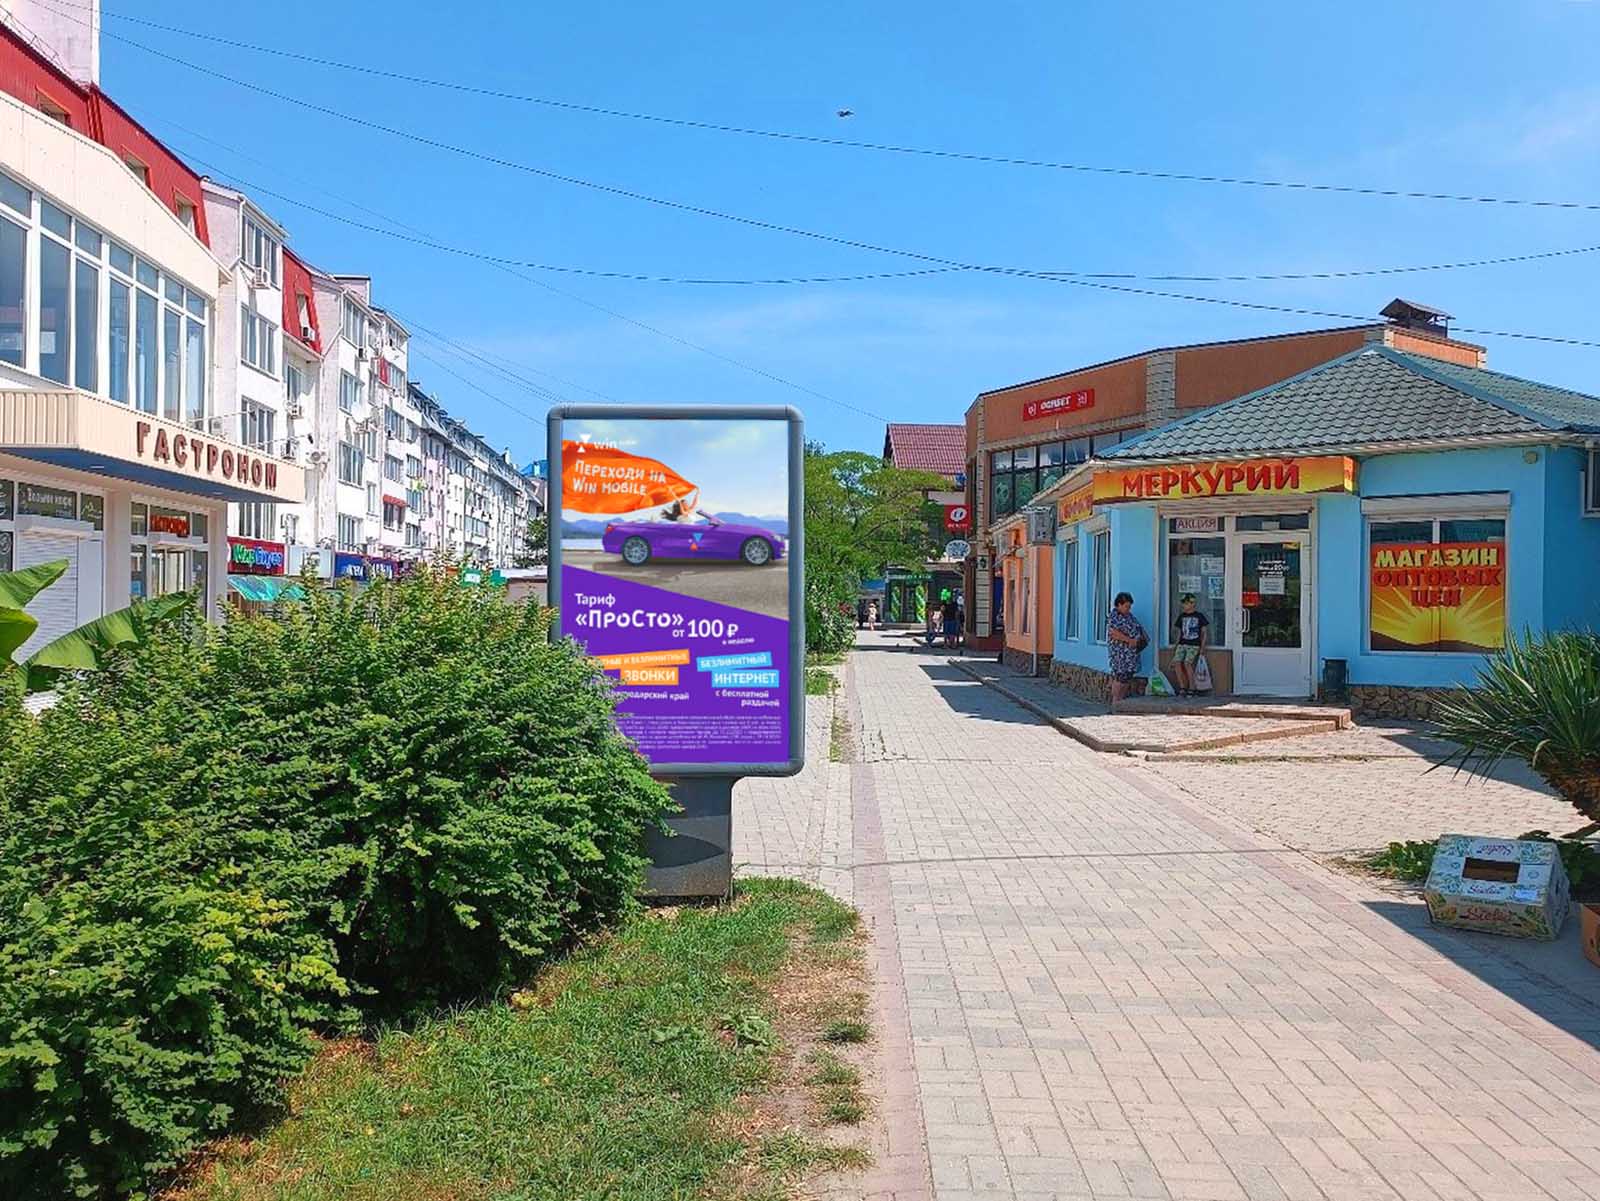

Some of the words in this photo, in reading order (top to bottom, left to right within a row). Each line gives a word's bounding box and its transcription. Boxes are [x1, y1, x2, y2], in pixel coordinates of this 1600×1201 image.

[136, 420, 277, 491] ГАСТРОНОМ
[1122, 458, 1300, 497] МЕРКУРИЙ
[1177, 519, 1217, 529] АКЦИЯ
[1375, 548, 1498, 567] МАГАЗИН
[1373, 568, 1502, 587] ОПТОВЫХ
[575, 593, 616, 608] Тариф
[1410, 588, 1461, 607] ЦЕН
[672, 629, 685, 638] от
[687, 618, 724, 638] 100
[700, 654, 767, 669] БЕЗЛИМИТНЫЙ
[624, 669, 676, 681] ЗВОНКИ
[714, 672, 777, 684] ИНТЕРНЕТ
[721, 688, 769, 698] бесплатной
